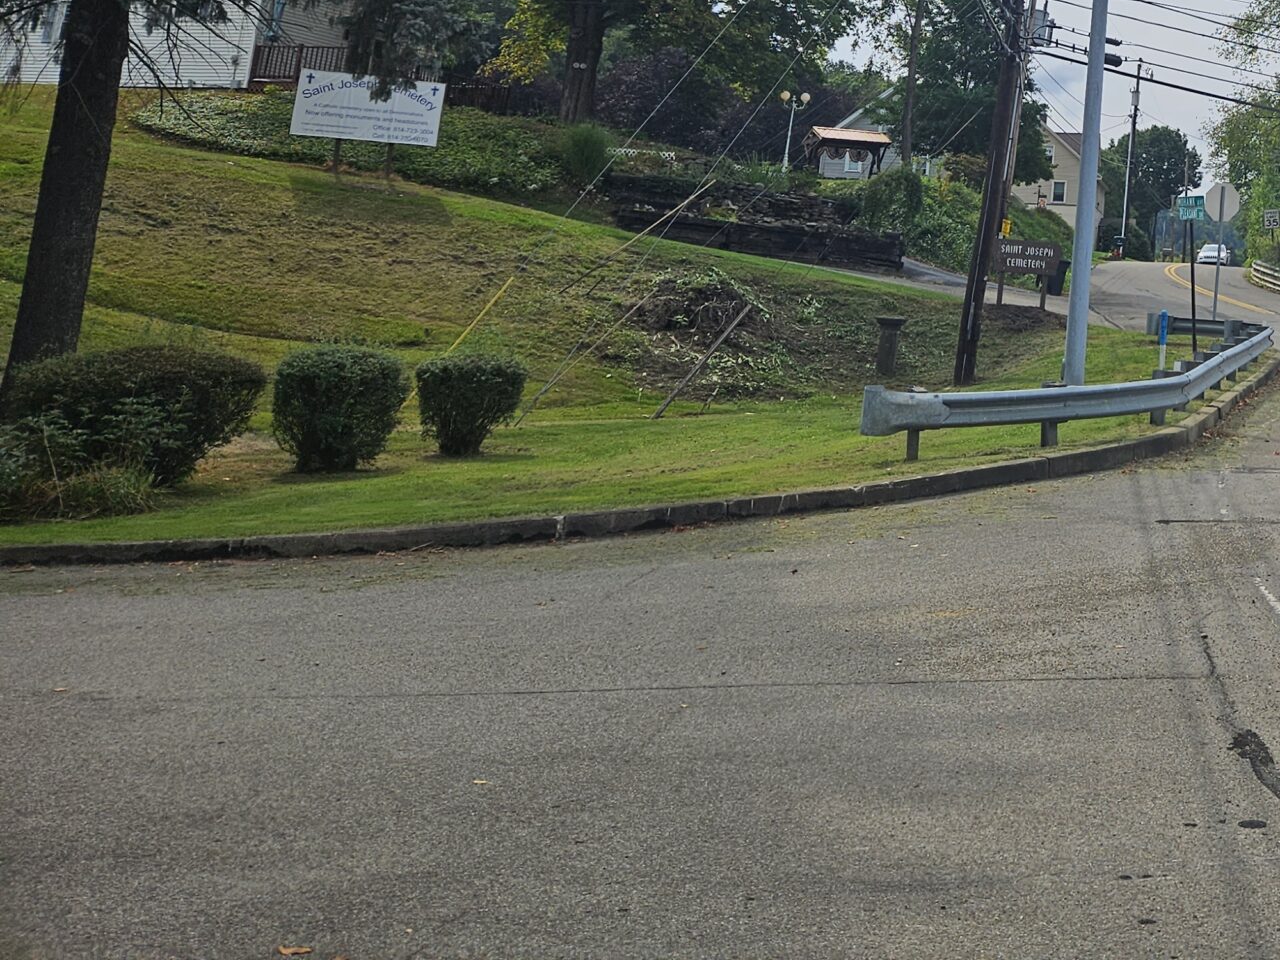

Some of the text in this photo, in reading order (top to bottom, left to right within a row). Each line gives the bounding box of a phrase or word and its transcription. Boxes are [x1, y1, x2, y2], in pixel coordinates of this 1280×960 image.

[302, 82, 335, 99] Saint
[389, 83, 437, 111] emetery
[321, 111, 344, 119] offering
[1265, 218, 1279, 227] 35
[1001, 244, 1054, 257] SAINT JOSEPH
[1006, 257, 1046, 269] CEMETERY
